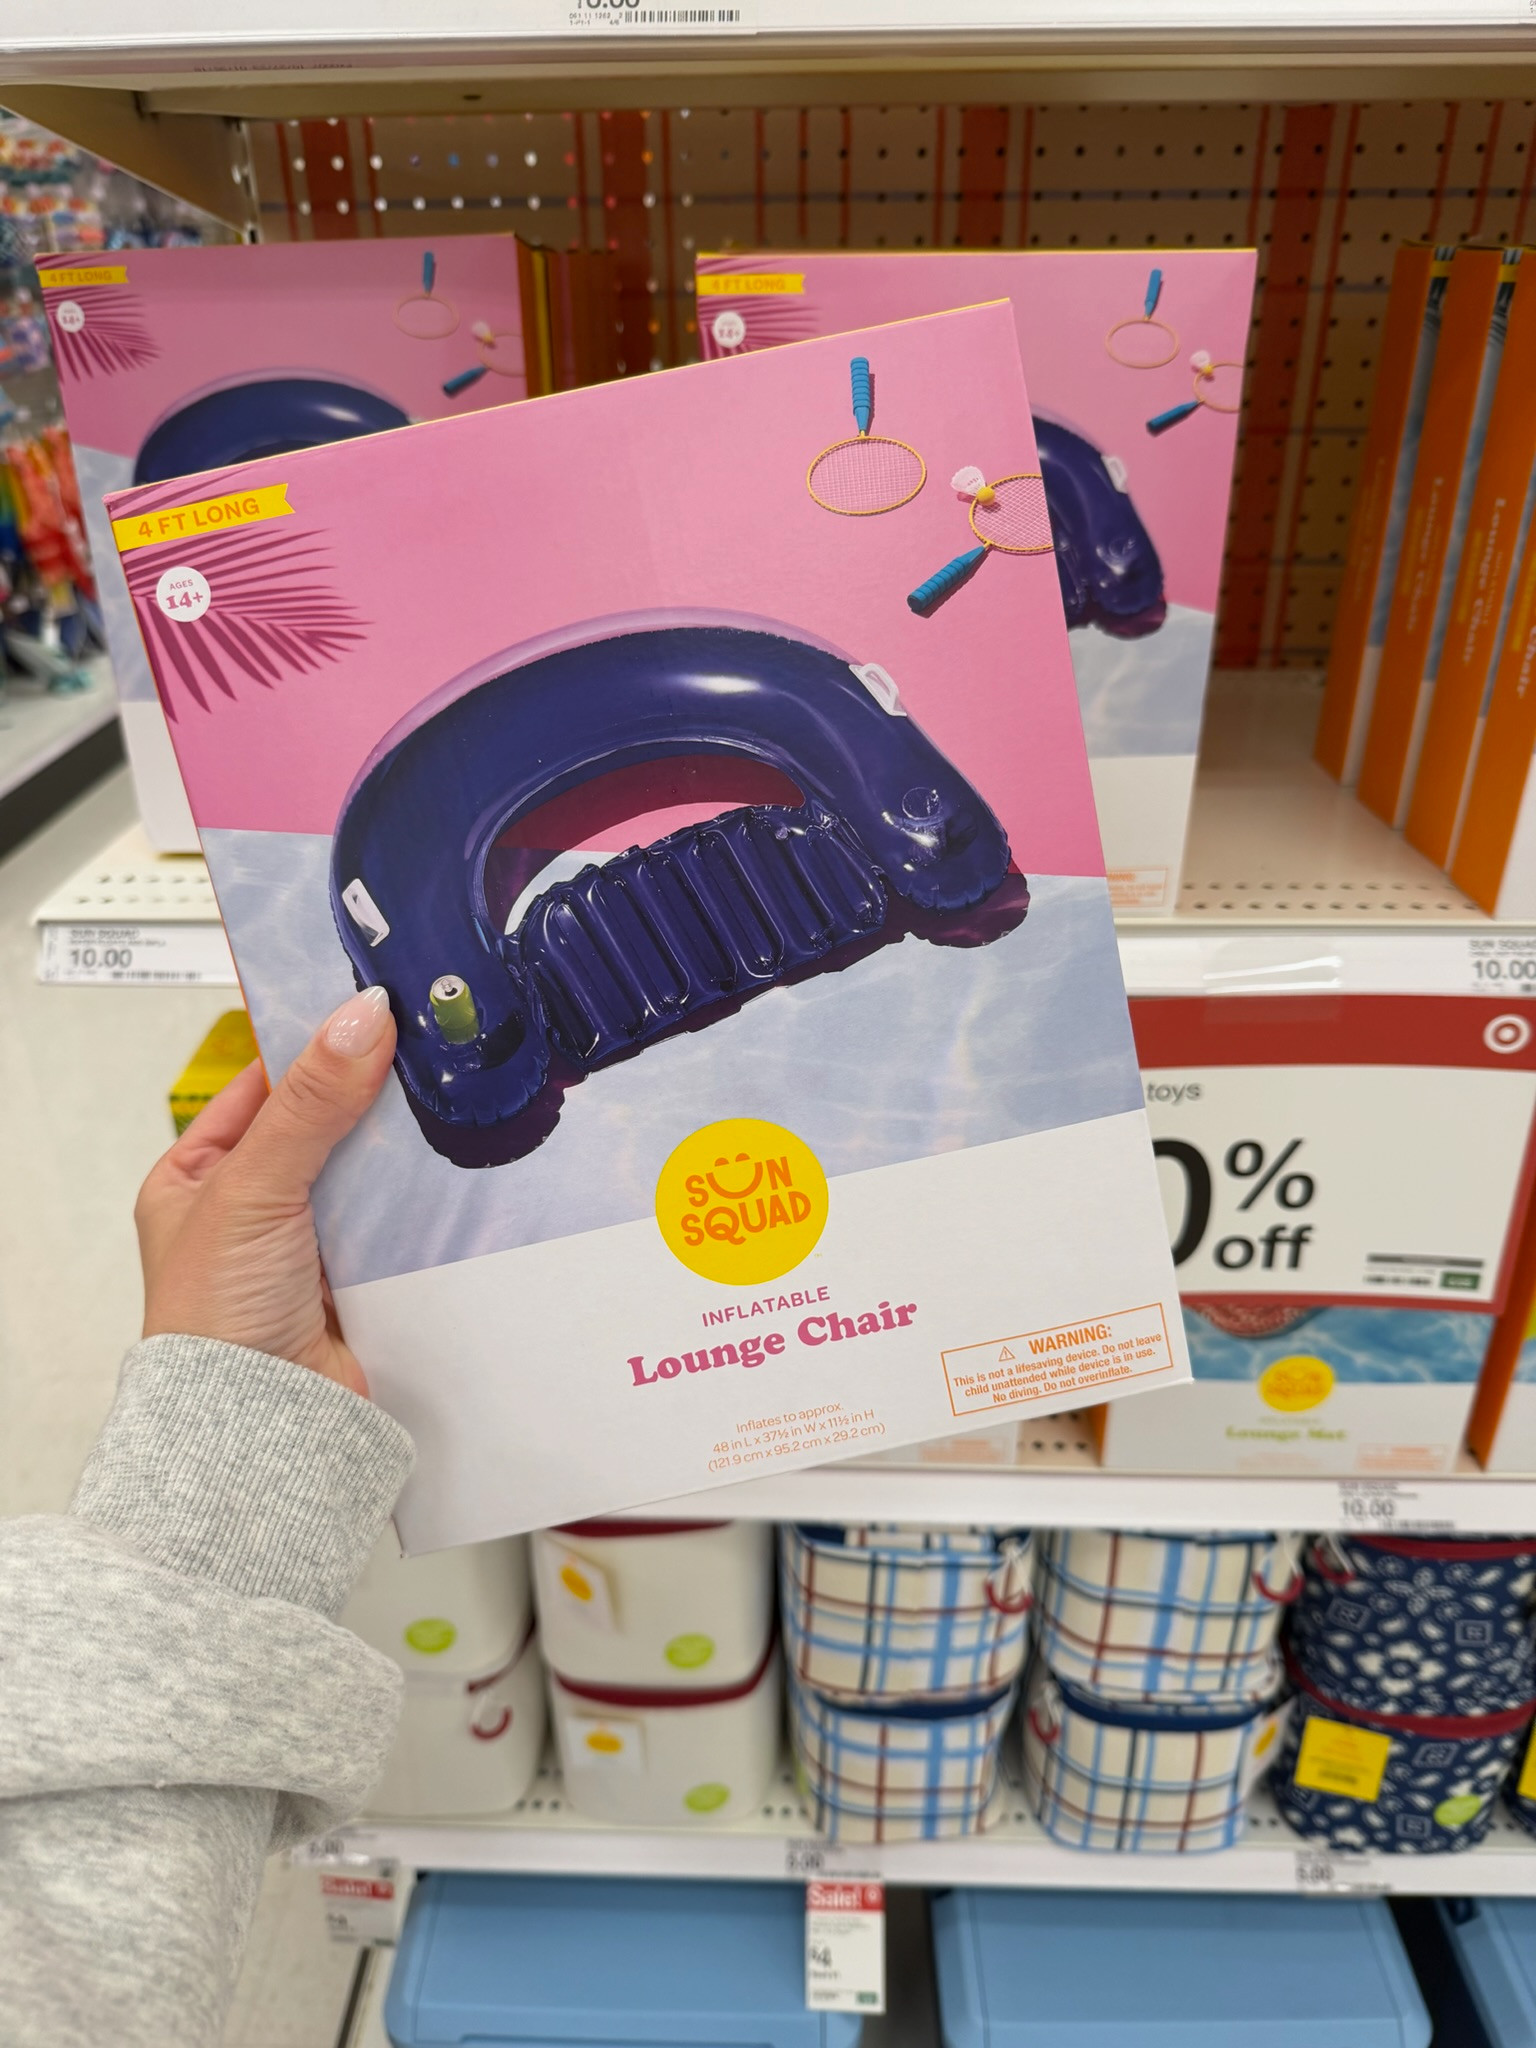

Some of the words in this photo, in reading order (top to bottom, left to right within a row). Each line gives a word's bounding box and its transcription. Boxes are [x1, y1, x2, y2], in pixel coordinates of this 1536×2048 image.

[60, 272, 74, 282] FT
[77, 270, 113, 281] LONG
[724, 279, 740, 291] FT
[745, 278, 786, 290] LONG
[138, 521, 153, 538] 4
[158, 513, 186, 535] FT
[193, 497, 260, 527] LONG
[1479, 498, 1506, 590] Lounge
[166, 591, 203, 610] 14+
[169, 579, 194, 591] AGES
[1463, 598, 1483, 666] Chair
[71, 949, 132, 968] 10.00
[1471, 960, 1536, 979] 10.00
[1147, 1082, 1202, 1104] toys
[685, 1153, 793, 1207] SUN
[681, 1191, 812, 1246] SQUAD
[1213, 1224, 1315, 1270] off
[702, 1286, 830, 1327] INFLATABLE
[627, 1332, 786, 1387] Lounge
[797, 1301, 918, 1346] Chair
[1028, 1323, 1112, 1355] WARNING:
[953, 1375, 975, 1387] This
[976, 1372, 986, 1382] is
[988, 1369, 1005, 1380] not
[1007, 1368, 1014, 1376] a
[1015, 1355, 1063, 1374] lifesaving
[1065, 1349, 1100, 1362] device.
[1103, 1345, 1116, 1355] Do
[1117, 1340, 1134, 1351] not
[1136, 1333, 1162, 1348] leave
[965, 1384, 989, 1397] child
[991, 1372, 1047, 1391] unattended
[1049, 1366, 1076, 1380] while
[1078, 1359, 1110, 1373] device
[1112, 1355, 1122, 1365] is
[1124, 1352, 1133, 1362] in
[1135, 1349, 1156, 1360] use.
[993, 1392, 1007, 1403] No
[1009, 1384, 1042, 1401] diving.
[1044, 1382, 1057, 1392] Do
[1059, 1378, 1076, 1389] not
[1078, 1365, 1133, 1385] overinflate.
[713, 1441, 730, 1453] 48
[731, 1438, 743, 1450] in
[744, 1436, 752, 1448] L
[753, 1436, 761, 1445] x
[791, 1425, 803, 1437] in
[803, 1421, 817, 1433] W
[818, 1421, 827, 1430] x
[851, 1412, 863, 1424] in
[863, 1408, 875, 1420] H
[736, 1416, 782, 1433] Inflates
[783, 1412, 797, 1423] to
[799, 1402, 844, 1421] approx.
[708, 1453, 742, 1472] (121.9
[743, 1450, 764, 1462] cm
[765, 1449, 773, 1458] x
[774, 1441, 800, 1456] 95.2
[802, 1438, 822, 1449] cm
[824, 1435, 832, 1444] x
[833, 1427, 859, 1443] 29.2
[860, 1422, 886, 1437] cm)
[807, 1885, 862, 1909] Sale!
